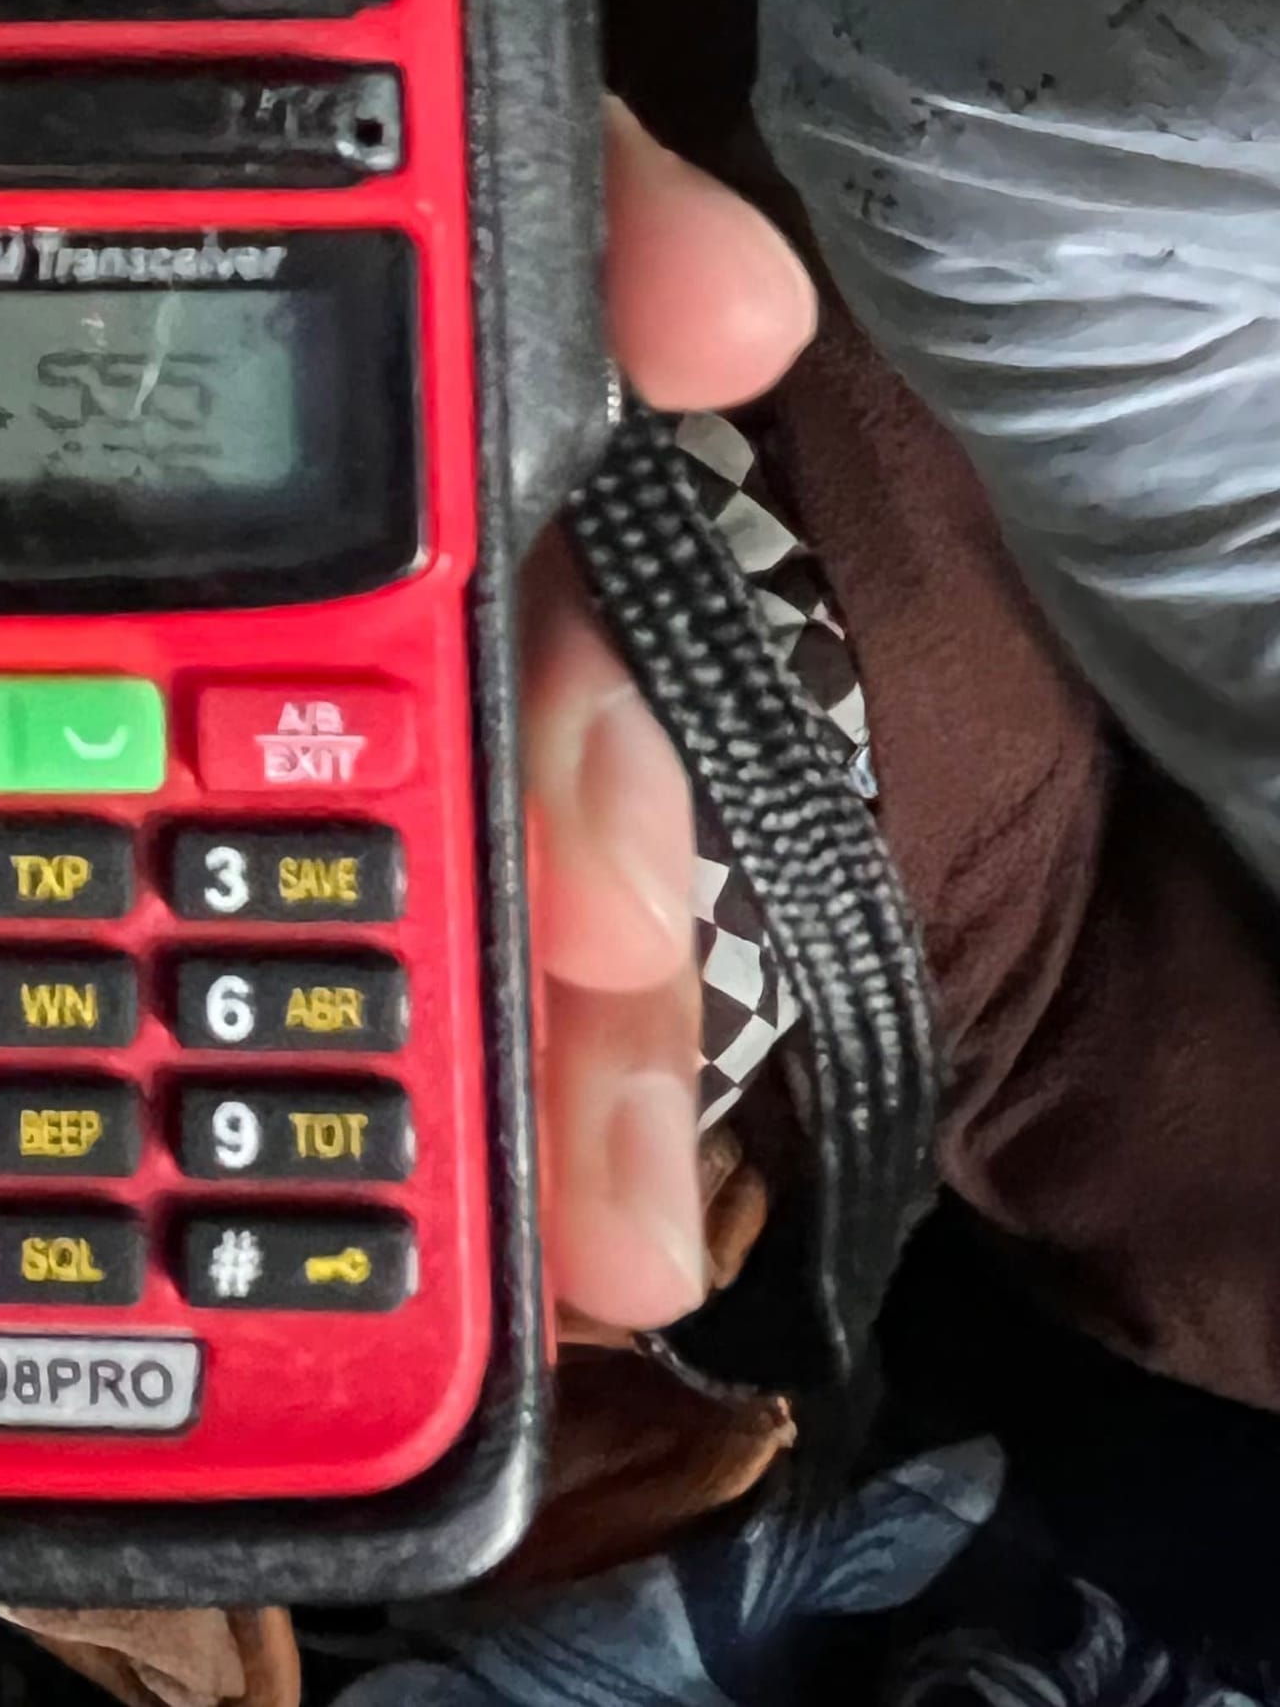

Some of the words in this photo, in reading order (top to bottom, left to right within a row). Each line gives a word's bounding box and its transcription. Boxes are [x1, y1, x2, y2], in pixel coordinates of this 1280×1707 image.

[31, 226, 288, 283] Transceiver
[263, 744, 360, 782] EXIT
[10, 854, 91, 900] TXP
[204, 845, 250, 913] 3
[278, 857, 358, 903] SAVE
[205, 975, 255, 1042] 6
[19, 1109, 101, 1156] BEEP
[212, 1101, 261, 1169] 9
[289, 1112, 368, 1158] TOT
[21, 1235, 103, 1283] SQL
[208, 1229, 263, 1297] #
